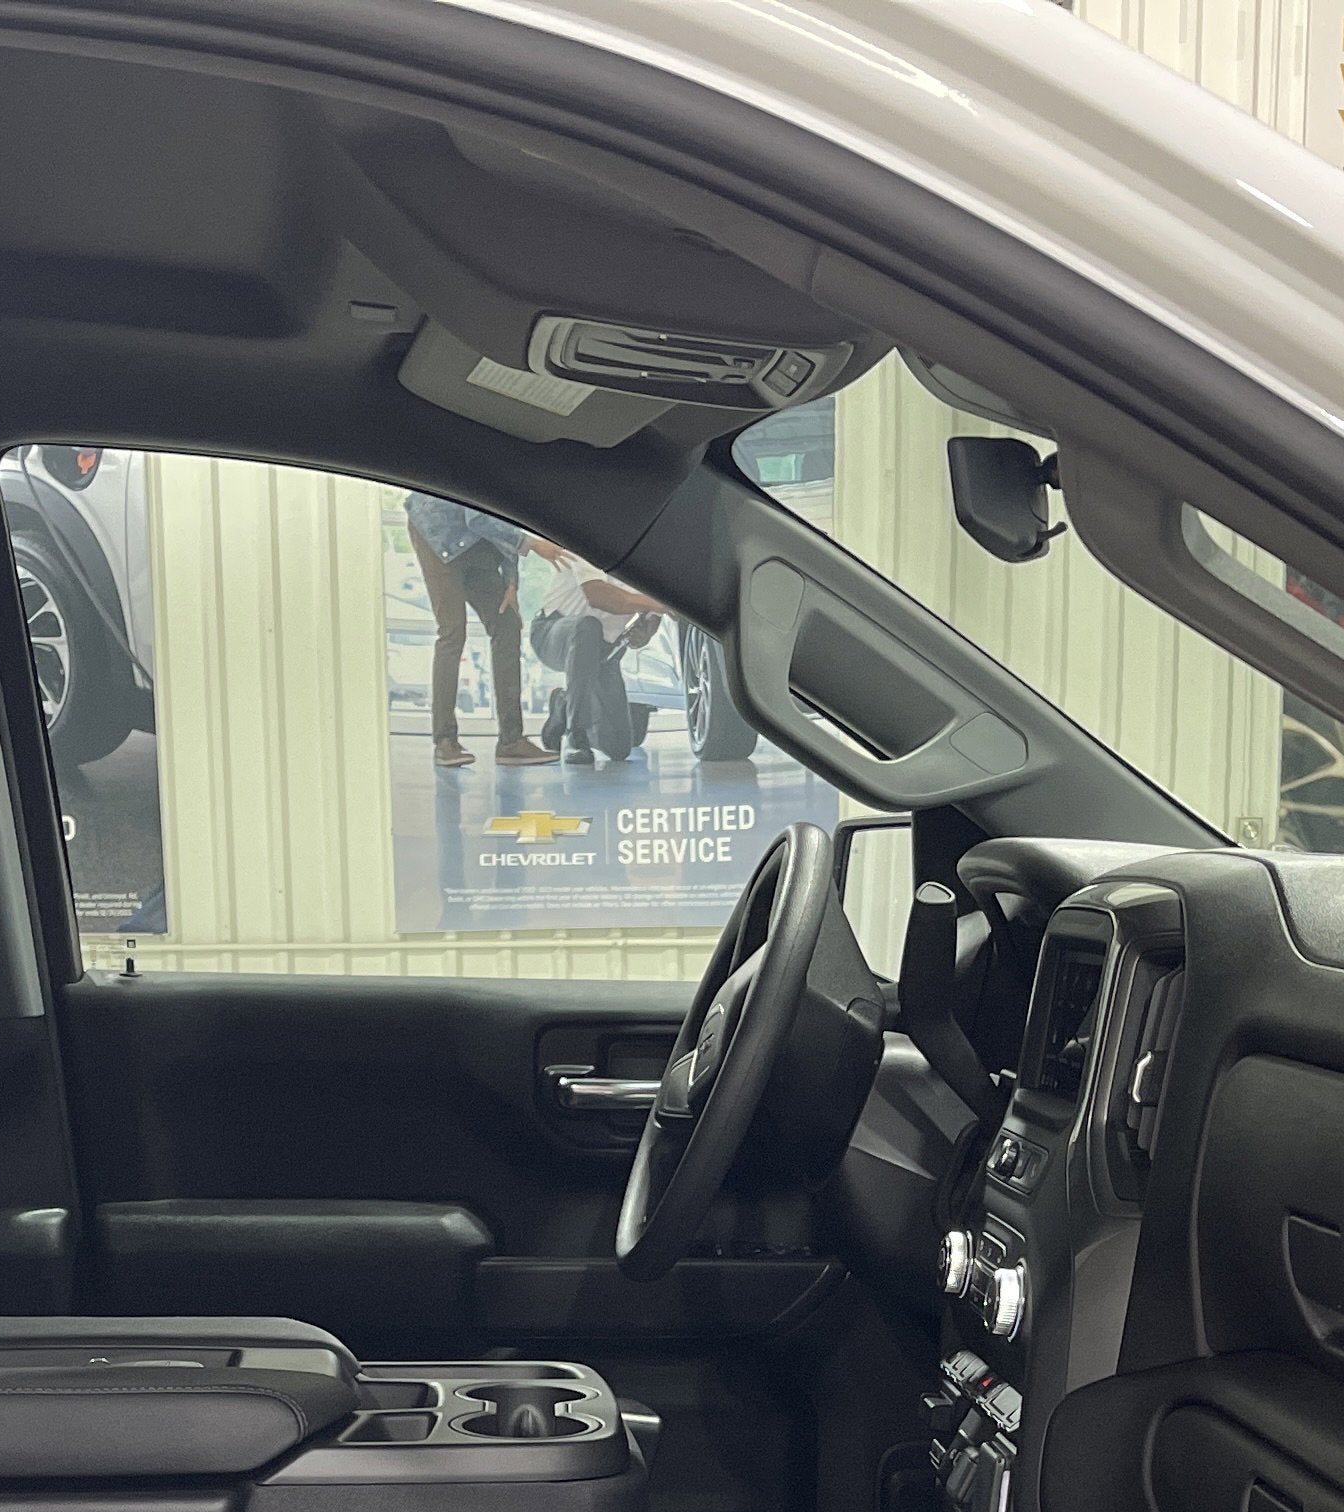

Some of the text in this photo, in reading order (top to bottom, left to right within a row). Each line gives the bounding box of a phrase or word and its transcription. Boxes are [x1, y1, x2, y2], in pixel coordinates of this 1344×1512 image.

[616, 804, 756, 834] CERTIFIED
[479, 852, 598, 867] CHEVROLET
[617, 836, 733, 865] SERVICE
